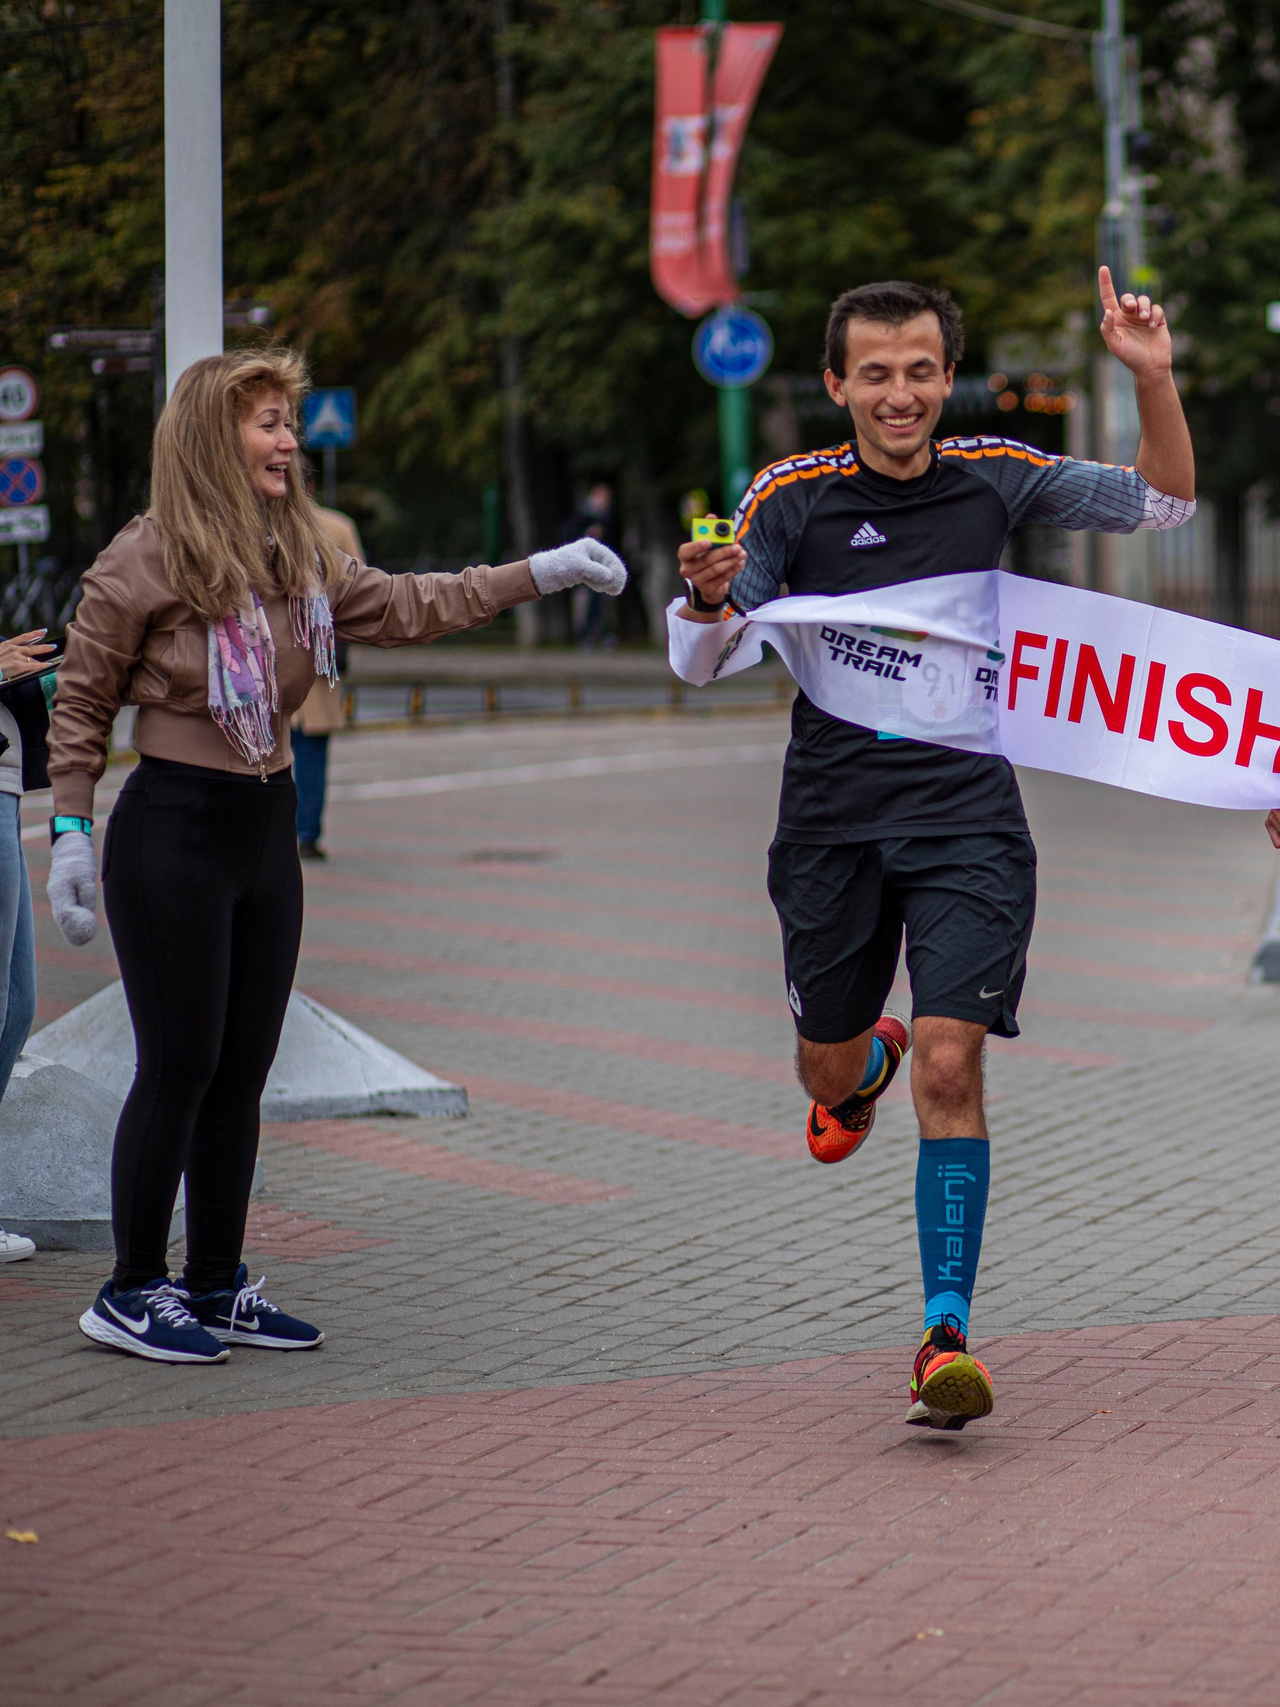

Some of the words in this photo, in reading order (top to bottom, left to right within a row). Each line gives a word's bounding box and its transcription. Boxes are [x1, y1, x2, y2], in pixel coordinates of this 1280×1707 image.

[850, 534, 886, 546] adidas
[820, 625, 923, 668] DREAM
[828, 645, 907, 682] TRAIL
